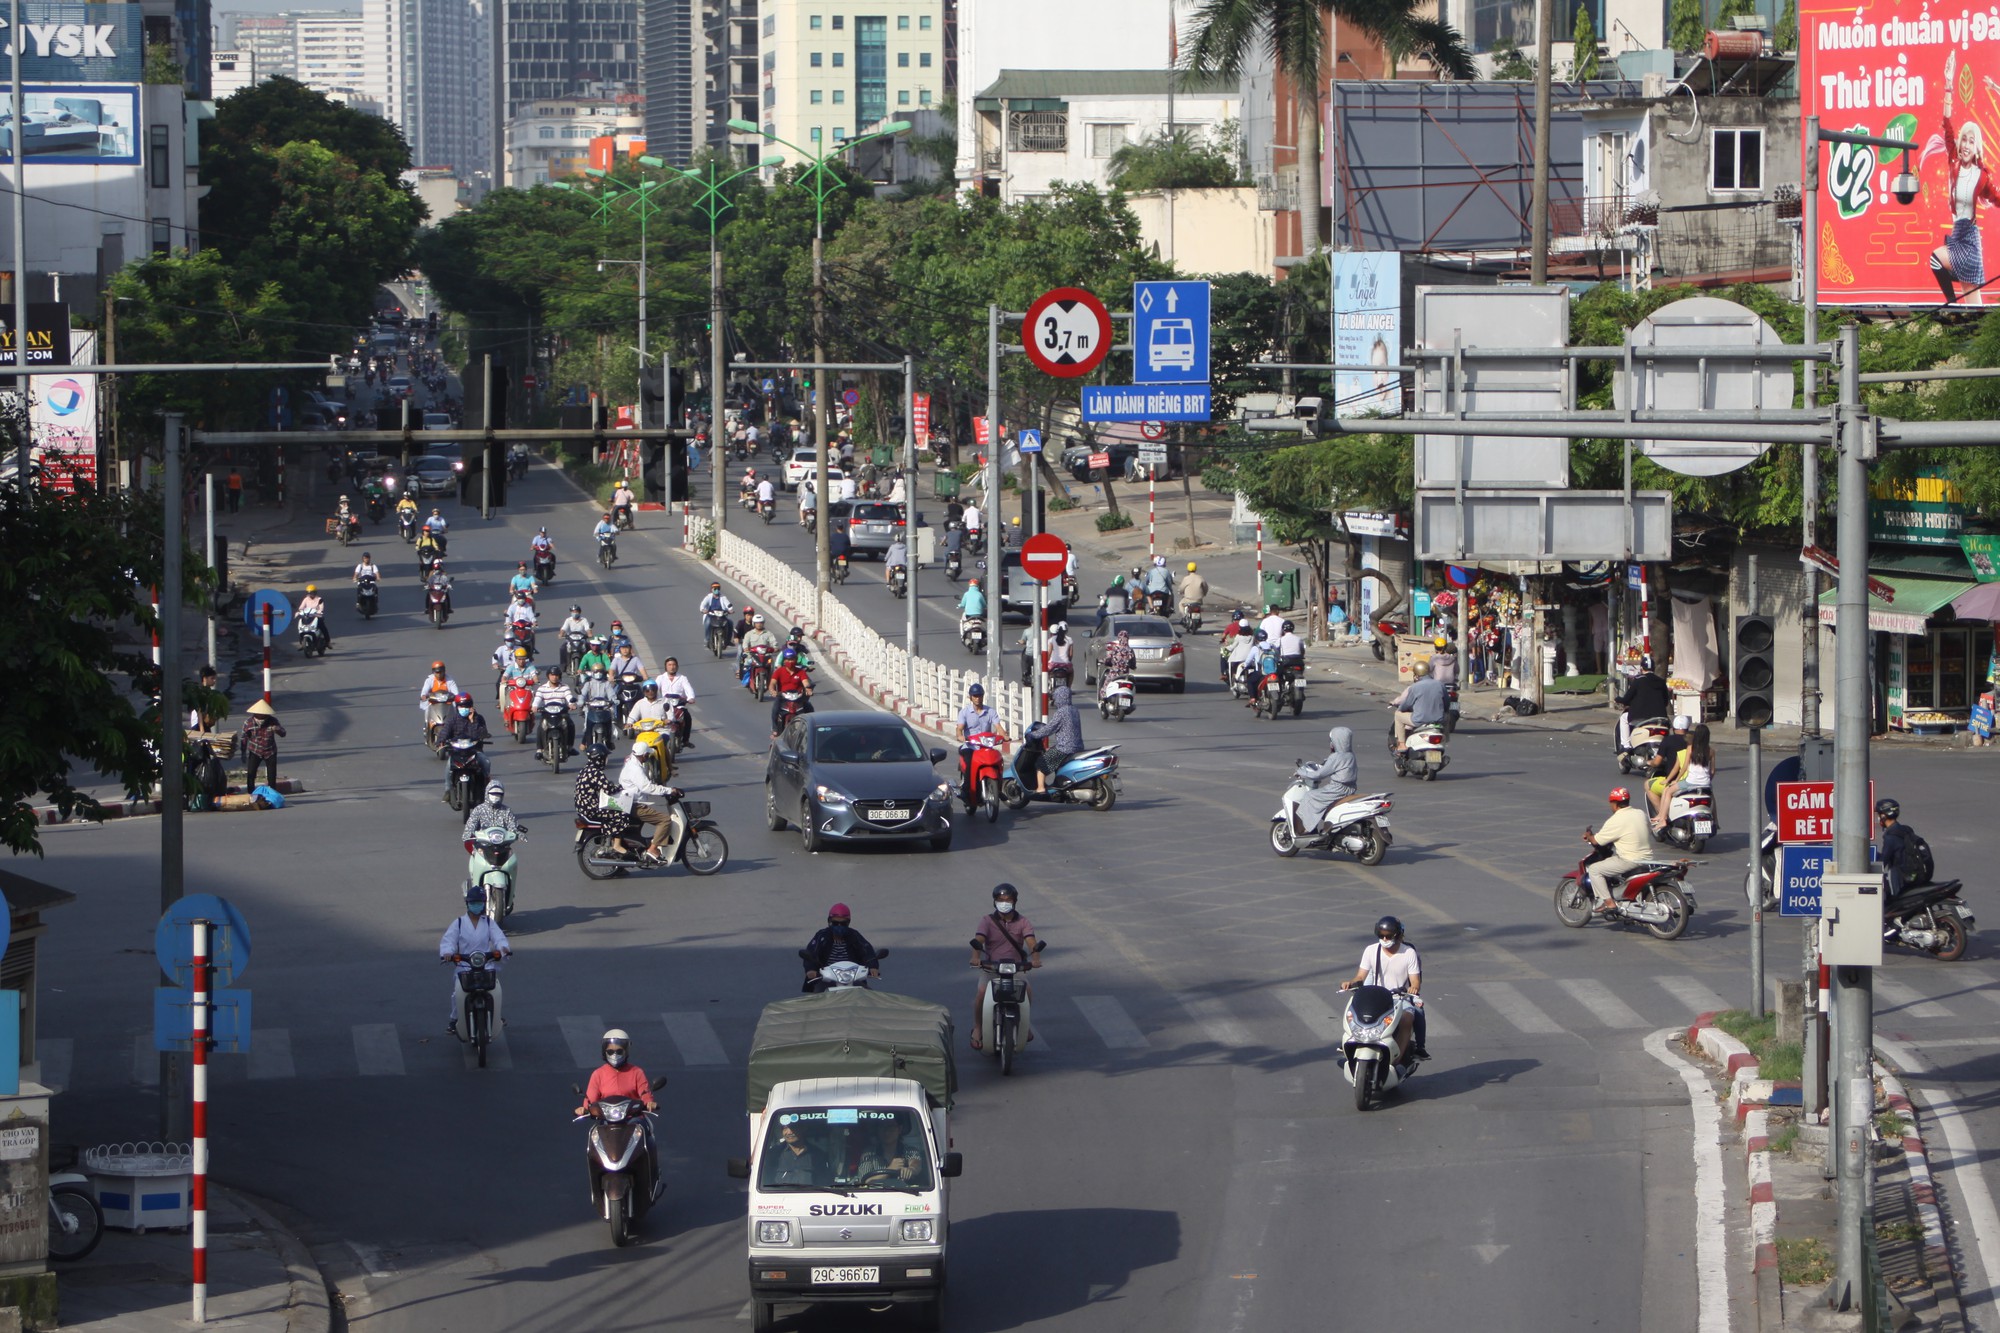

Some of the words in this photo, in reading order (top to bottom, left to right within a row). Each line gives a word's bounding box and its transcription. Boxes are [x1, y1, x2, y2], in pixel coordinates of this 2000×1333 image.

[1818, 6, 1877, 51] Muốn
[1881, 1, 1944, 47] chuẩn
[1949, 9, 1969, 50] vị
[4, 24, 117, 57] JYSK
[1821, 65, 1871, 110] Thử
[1875, 53, 1924, 108] liền
[1831, 141, 1870, 210] C2
[1349, 281, 1379, 308] Angel
[1367, 313, 1395, 331] ANGEL
[1077, 335, 1089, 349] m
[1089, 391, 1112, 415] LÀN
[1114, 391, 1145, 414] DÀNH
[1147, 391, 1182, 414] RIÊNG
[1183, 395, 1205, 413] BRT
[1884, 510, 1923, 528] THANH
[1966, 538, 1992, 552] Hoa
[1787, 788, 1826, 810] CẤM
[1795, 815, 1817, 836] RẼ
[1802, 859, 1819, 870] XE
[21, 1128, 36, 1137] VAY
[809, 1204, 883, 1216] SUZUKI
